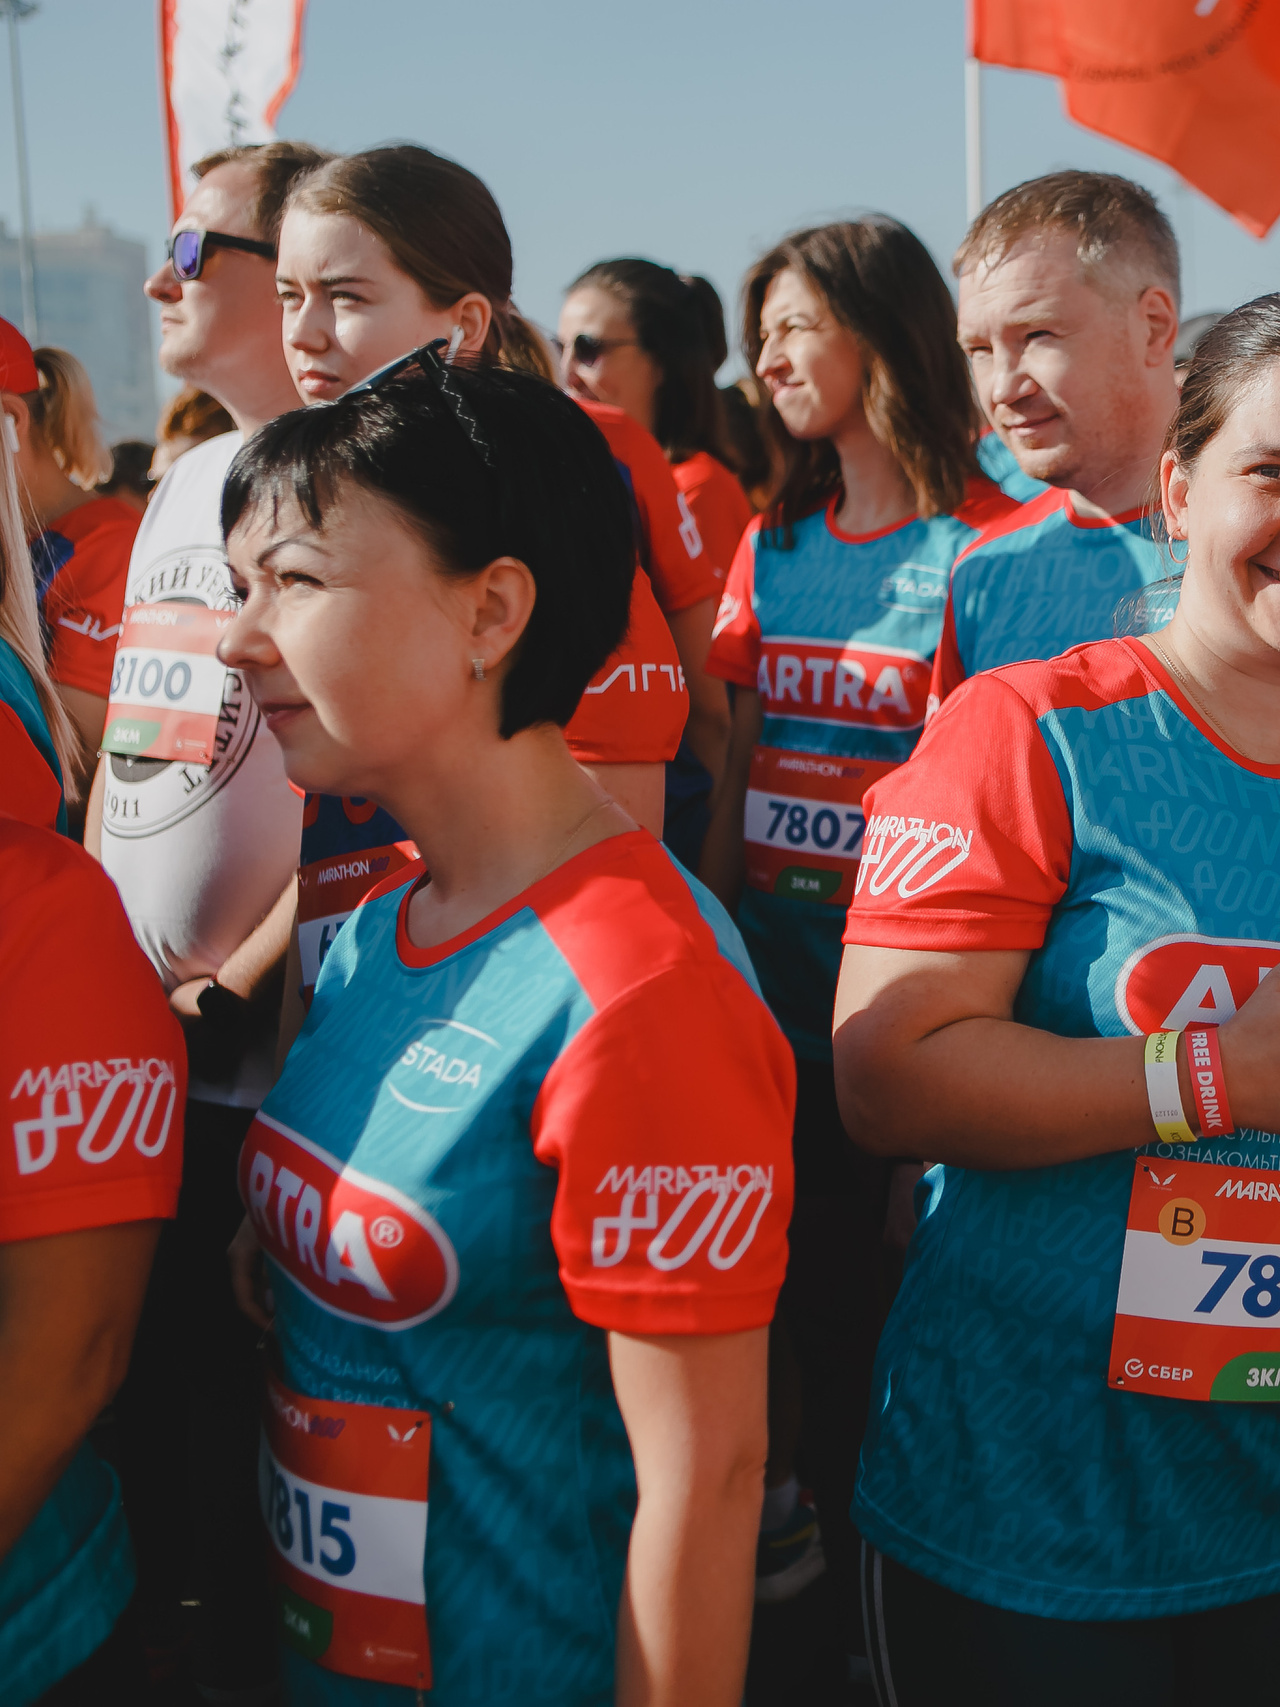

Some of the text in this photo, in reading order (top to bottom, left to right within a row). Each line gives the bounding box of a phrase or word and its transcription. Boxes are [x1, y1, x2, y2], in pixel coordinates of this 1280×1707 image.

[1134, 607, 1176, 625] STA
[757, 653, 912, 714] ARTRA
[766, 800, 866, 852] 7807
[865, 814, 973, 852] MARATHON
[9, 1058, 176, 1100] MARATHON
[401, 1041, 482, 1089] STADA
[1191, 1031, 1224, 1129] FREE DRINK
[594, 1164, 774, 1195] MARATHON
[250, 1150, 397, 1302] RTRA
[1148, 1364, 1194, 1382] СБЕР
